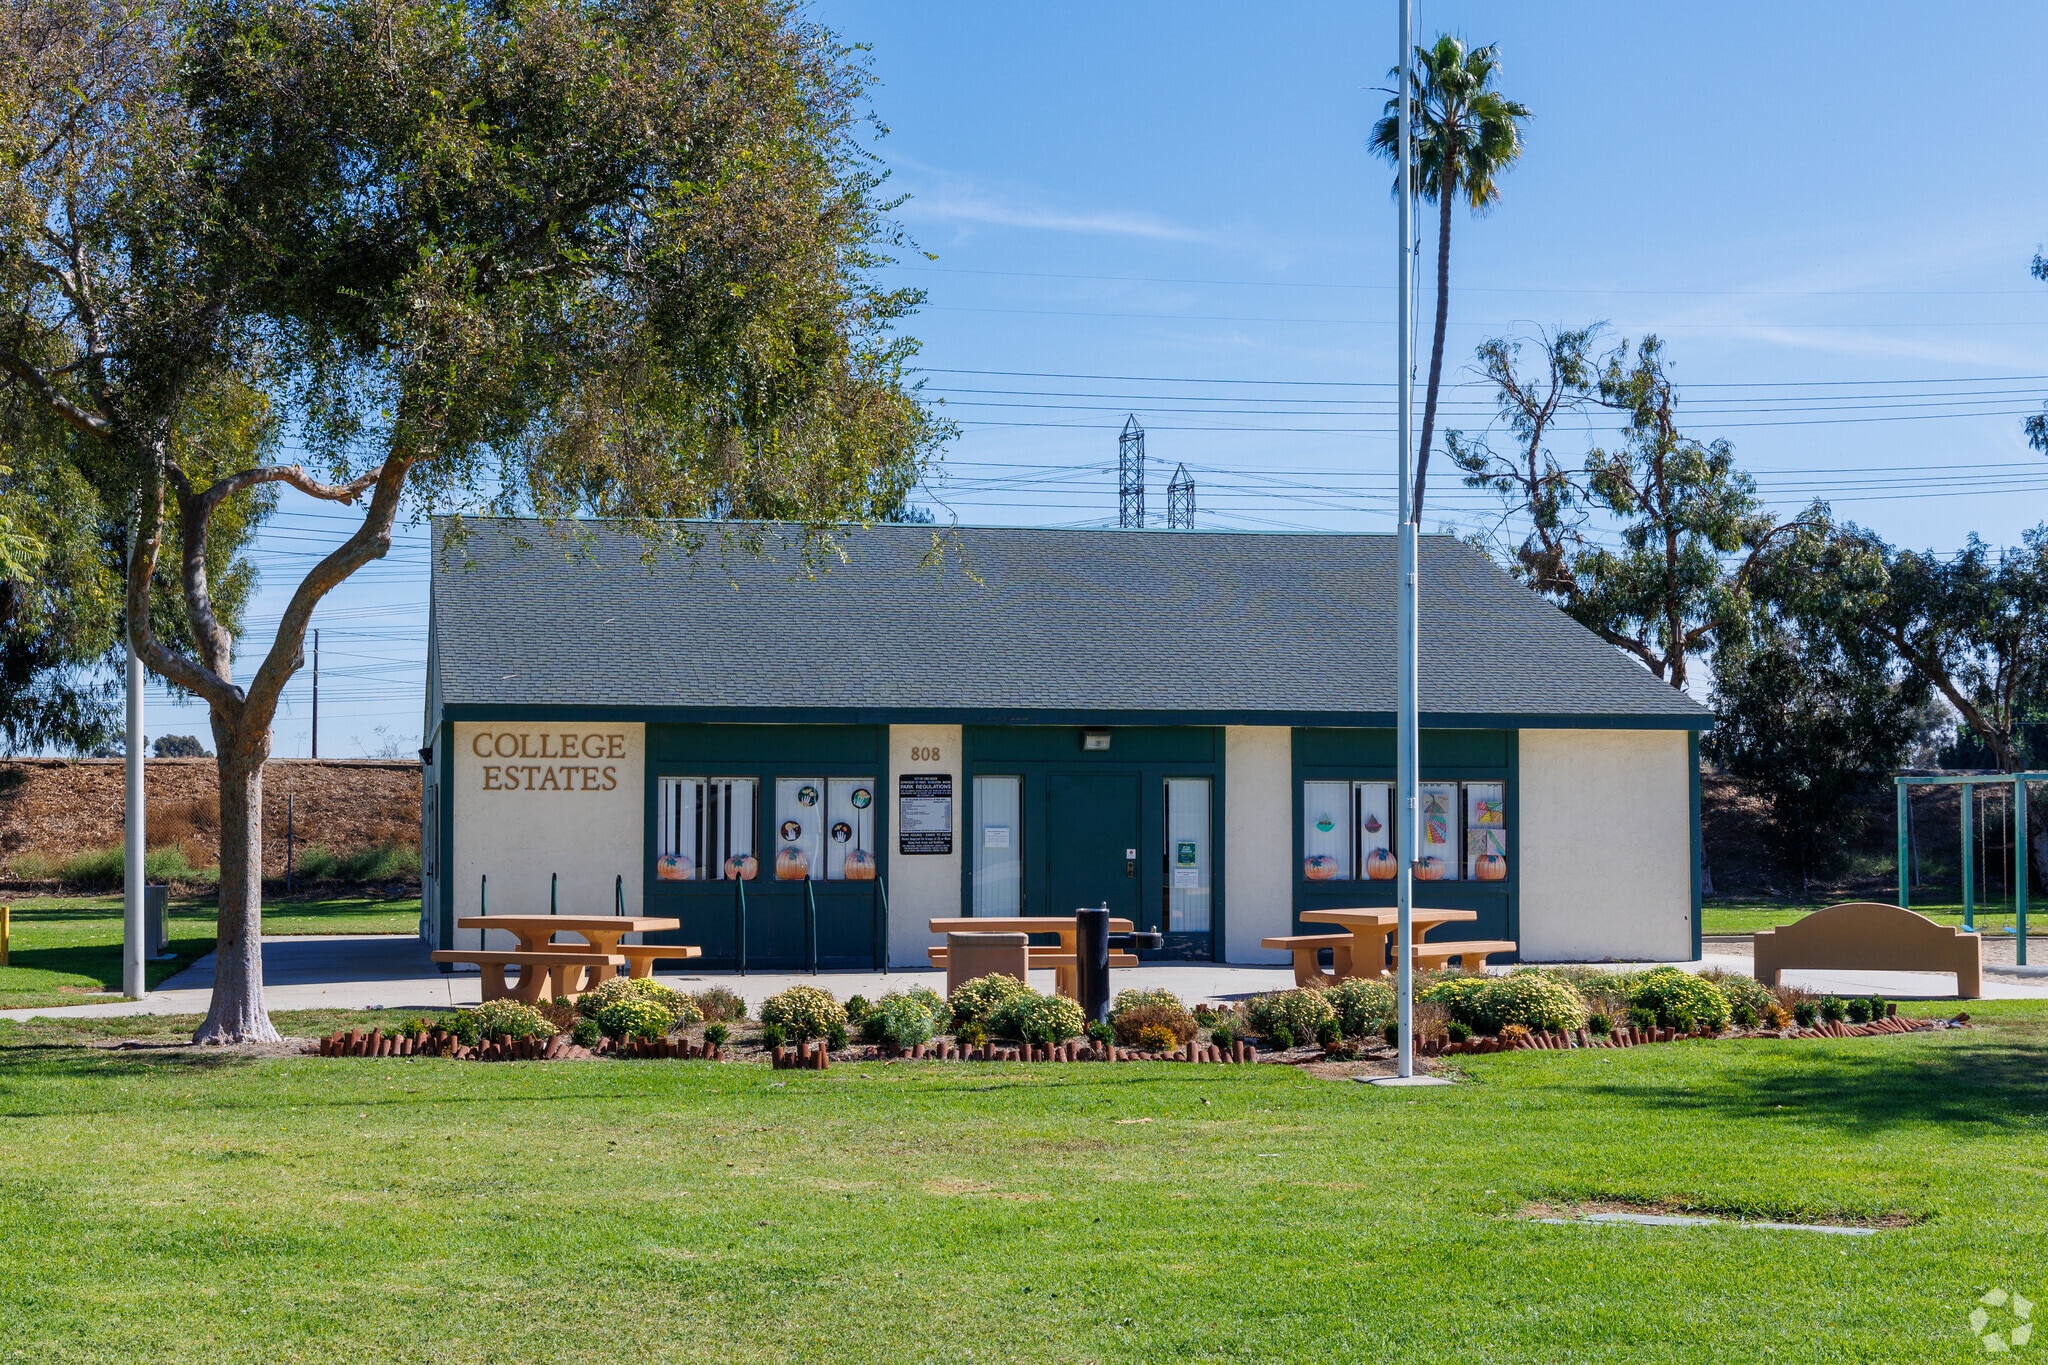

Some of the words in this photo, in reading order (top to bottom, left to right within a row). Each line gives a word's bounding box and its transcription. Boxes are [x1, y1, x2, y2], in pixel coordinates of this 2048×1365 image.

[472, 733, 627, 759] COLLEGE
[911, 746, 940, 761] 808
[482, 765, 617, 791] ESTATES
